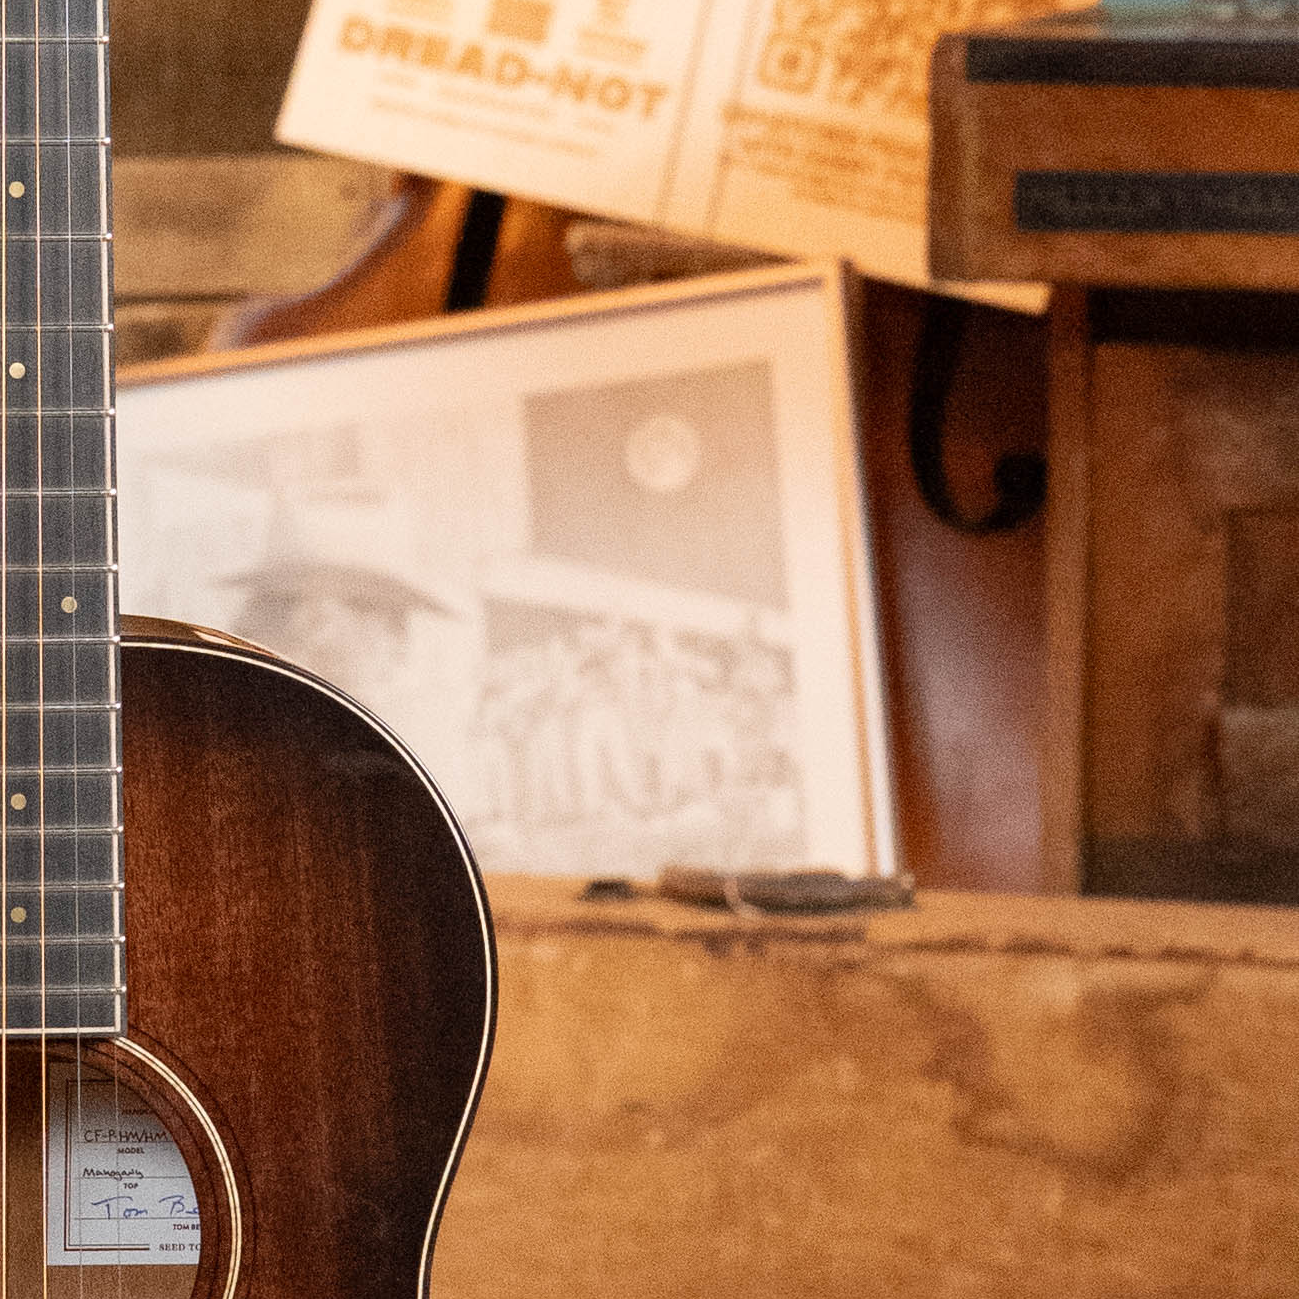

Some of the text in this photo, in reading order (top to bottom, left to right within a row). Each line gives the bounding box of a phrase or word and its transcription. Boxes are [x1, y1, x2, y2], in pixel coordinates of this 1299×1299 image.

[117, 1146, 145, 1155] MODEL
[90, 1195, 148, 1219] Tom
[173, 1223, 190, 1231] TOM
[158, 1243, 186, 1252] SEED
